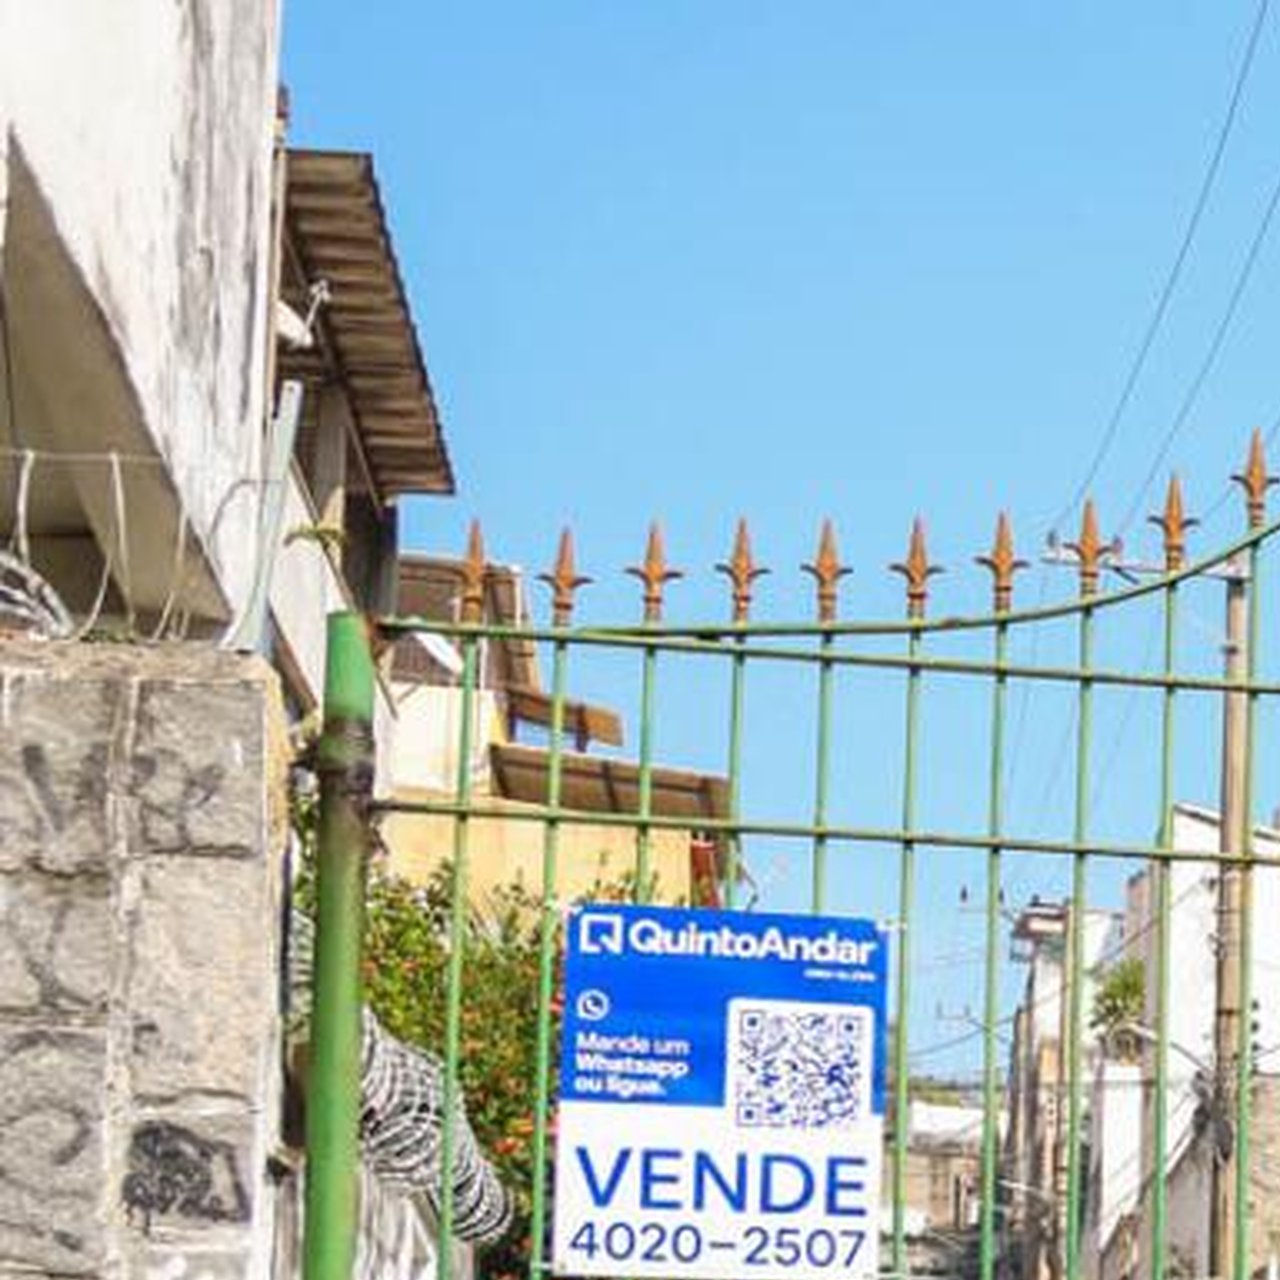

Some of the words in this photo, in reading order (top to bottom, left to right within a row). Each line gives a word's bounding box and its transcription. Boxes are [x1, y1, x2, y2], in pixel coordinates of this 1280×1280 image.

[628, 918, 878, 965] QuintoAndar
[653, 1039, 691, 1056] um
[574, 1145, 868, 1218] VENDE
[569, 1221, 867, 1269] 4020-2507
